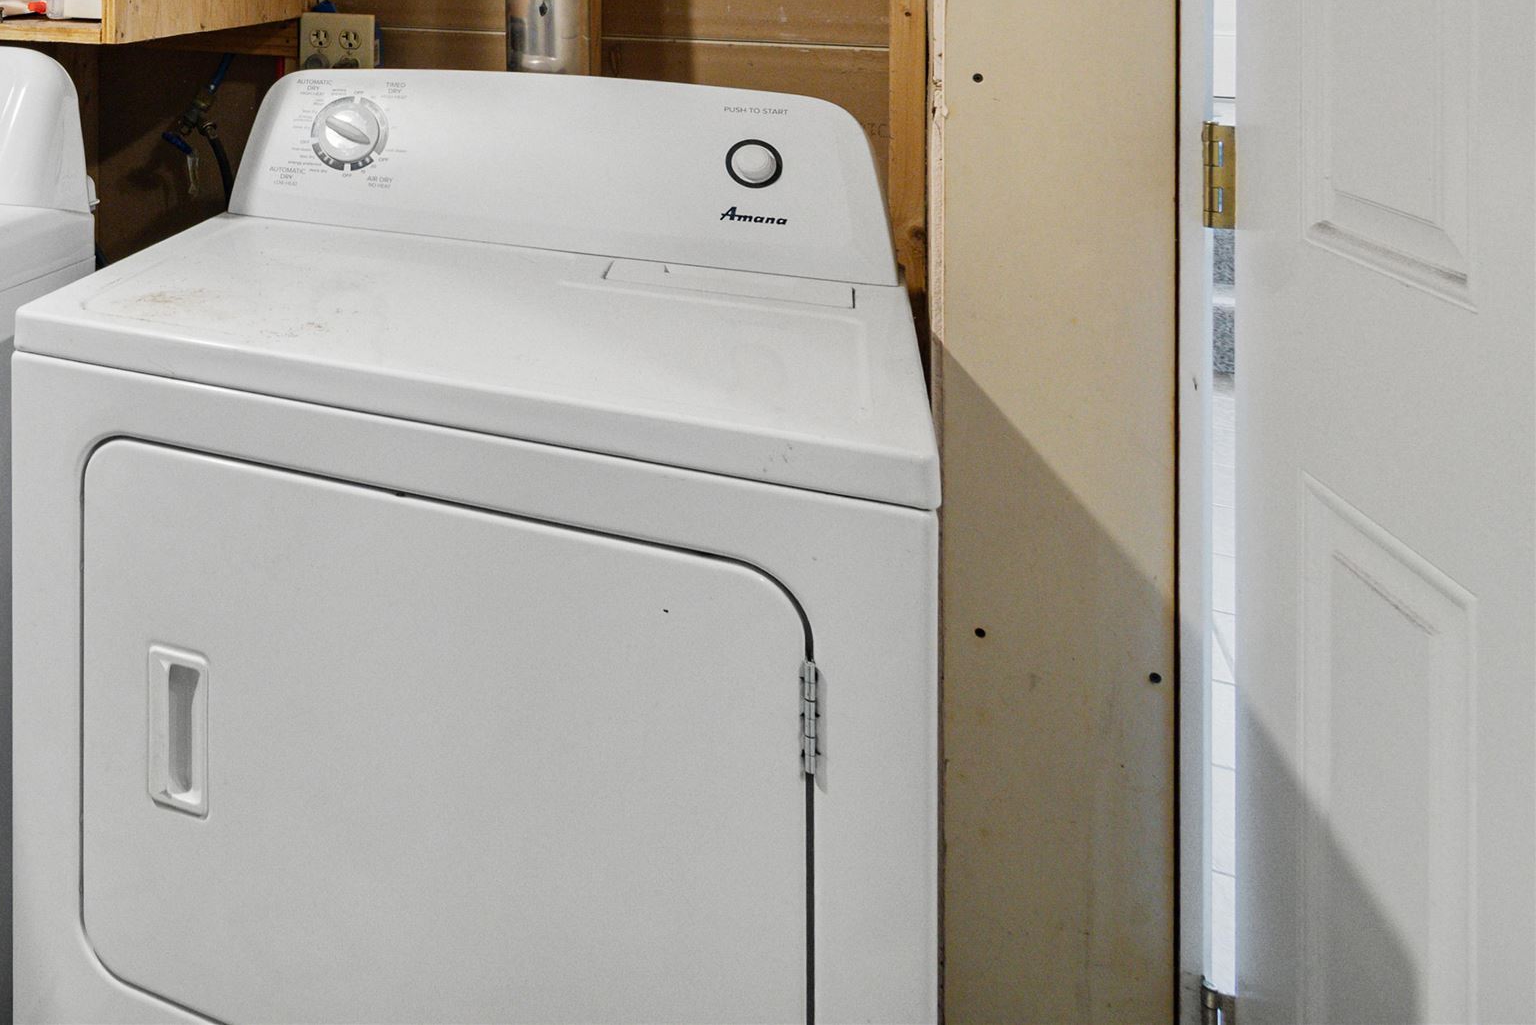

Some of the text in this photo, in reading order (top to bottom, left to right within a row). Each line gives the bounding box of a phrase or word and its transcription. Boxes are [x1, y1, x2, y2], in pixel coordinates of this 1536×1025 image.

[296, 78, 333, 86] AUTOMATIC
[269, 166, 306, 175] AUTOMATIC
[719, 206, 789, 226] Amana
